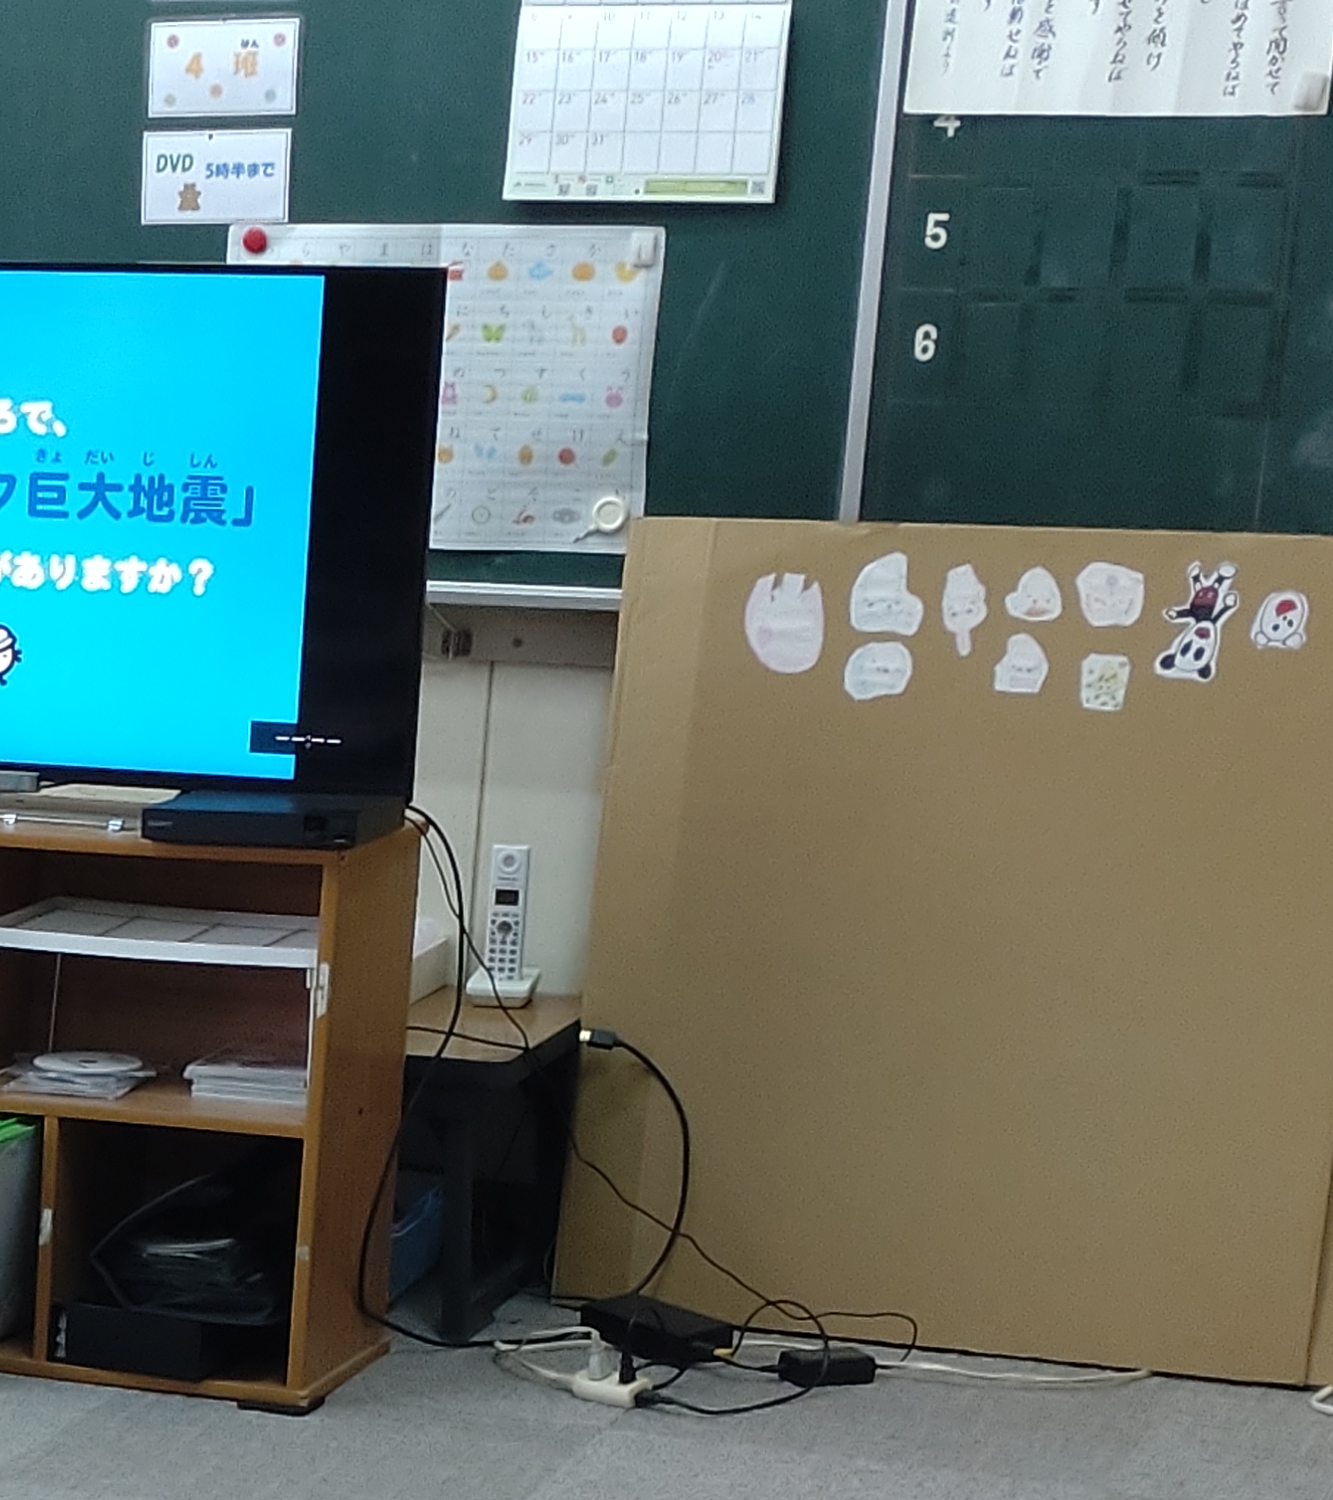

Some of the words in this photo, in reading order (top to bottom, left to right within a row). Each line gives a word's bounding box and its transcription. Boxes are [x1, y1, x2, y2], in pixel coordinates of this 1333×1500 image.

[1147, 0, 1167, 71] を傾け
[185, 52, 204, 79] 4
[233, 51, 259, 78] 班
[526, 52, 539, 63] 15
[562, 52, 574, 63] 16
[598, 52, 610, 63] 17
[635, 52, 647, 63] 18
[671, 52, 683, 63] 19
[707, 52, 722, 62] 20
[745, 52, 758, 62] 21
[522, 94, 535, 105] 22
[557, 94, 571, 105] 23
[594, 94, 608, 105] 24
[630, 94, 644, 105] 25
[667, 94, 681, 105] 26
[703, 94, 718, 105] 27
[741, 93, 755, 105] 28
[518, 135, 532, 146] 29
[555, 135, 569, 146] 30
[591, 135, 605, 146] 31
[156, 153, 195, 173] DVD
[205, 161, 276, 179] 5時半まで
[924, 213, 951, 250] 5
[913, 323, 938, 362] 6
[36, 449, 63, 464] きょ
[84, 450, 115, 465] だい
[142, 451, 156, 467] じ
[189, 452, 219, 469] しん
